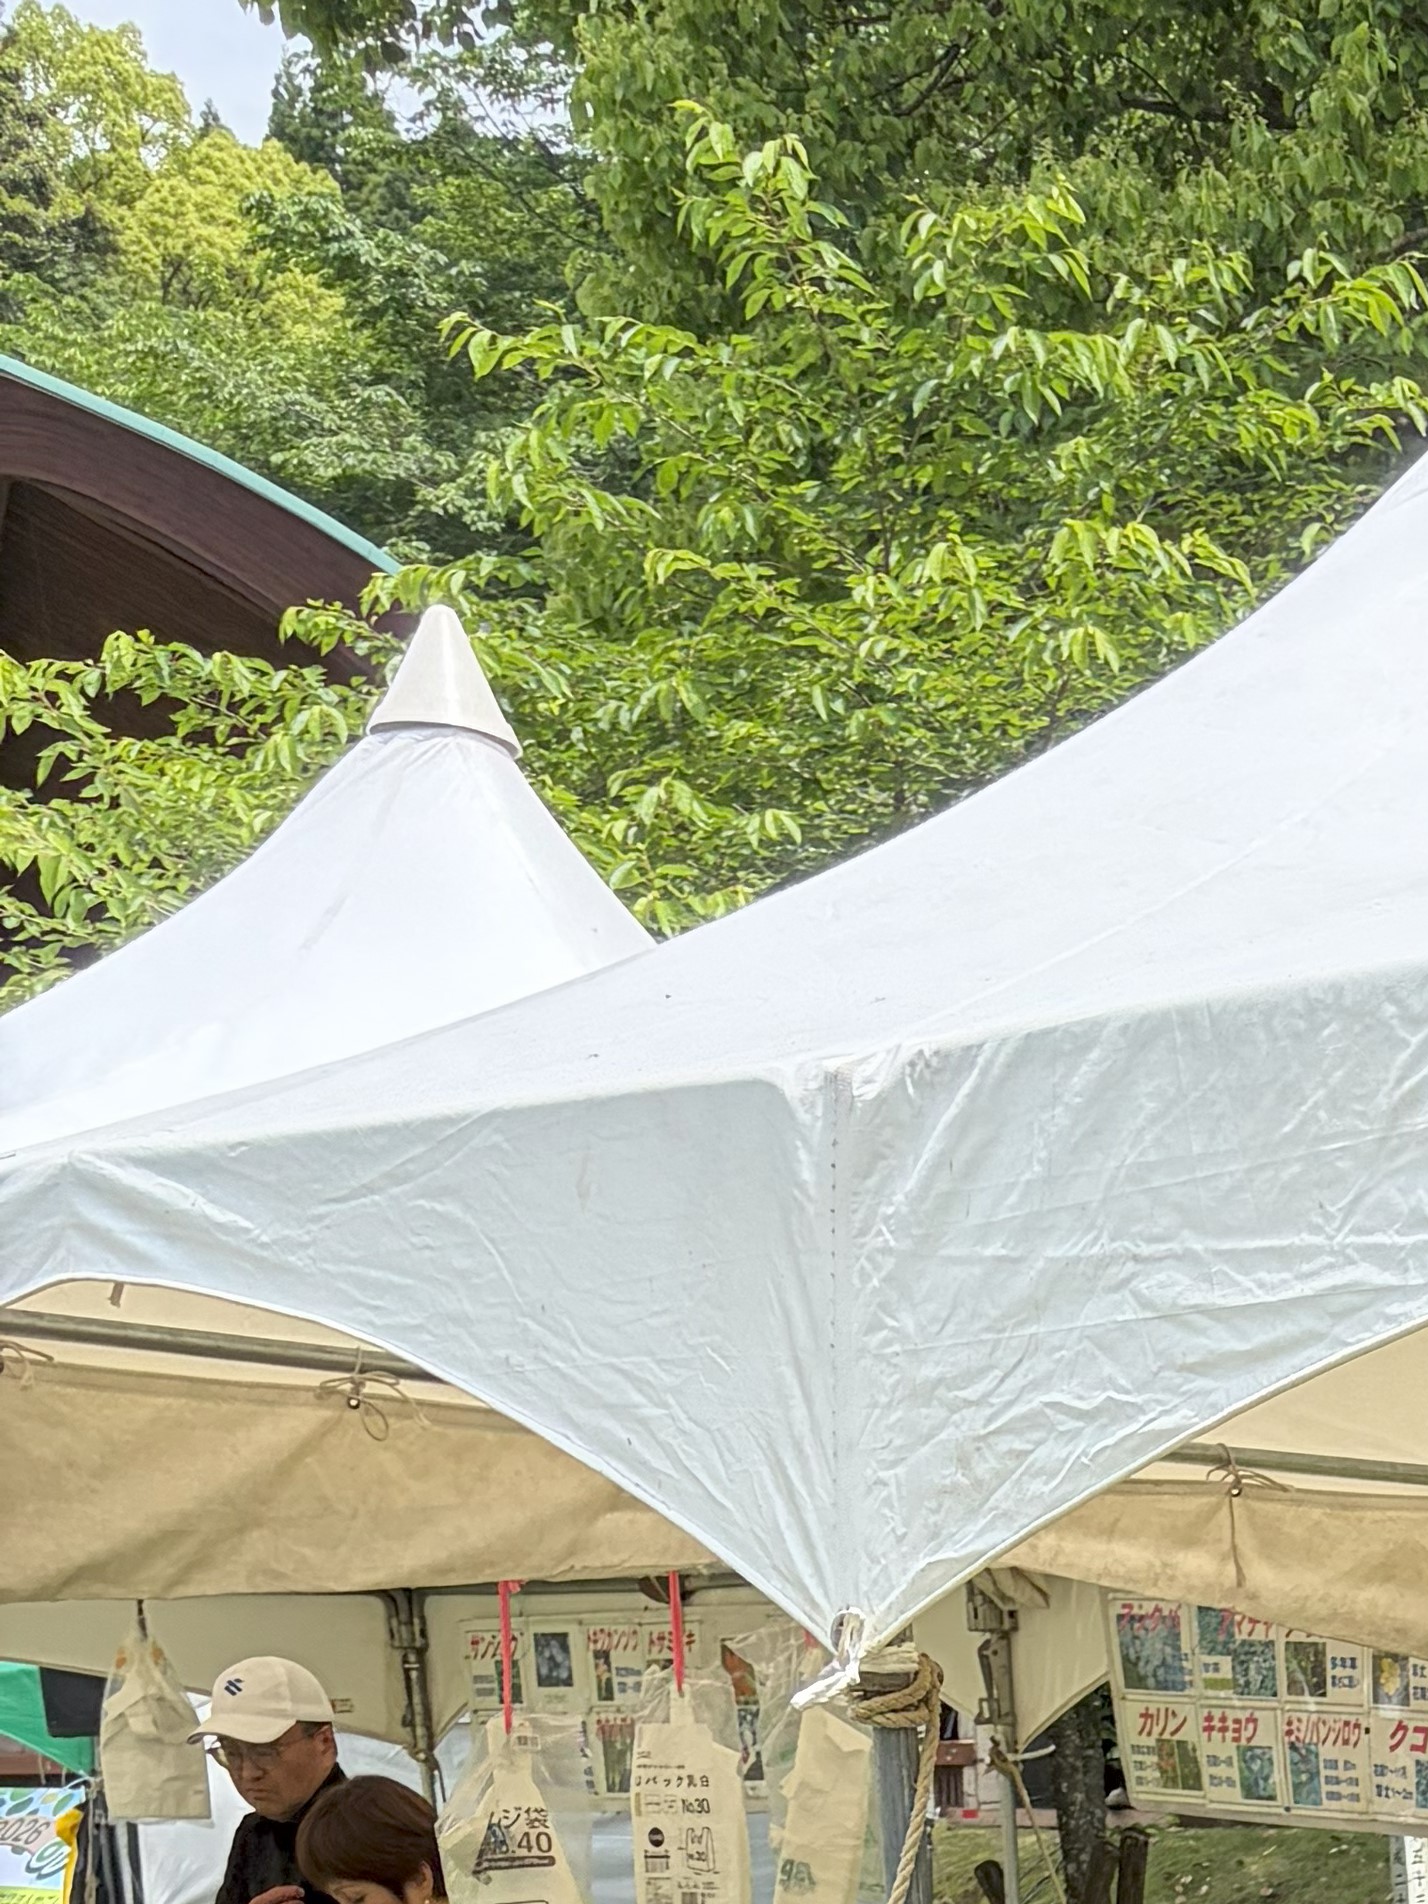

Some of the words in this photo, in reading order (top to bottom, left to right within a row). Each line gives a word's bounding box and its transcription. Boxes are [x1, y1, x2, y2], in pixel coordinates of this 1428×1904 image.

[1138, 1706, 1188, 1738] カリン
[1202, 1710, 1259, 1745] キキョウ
